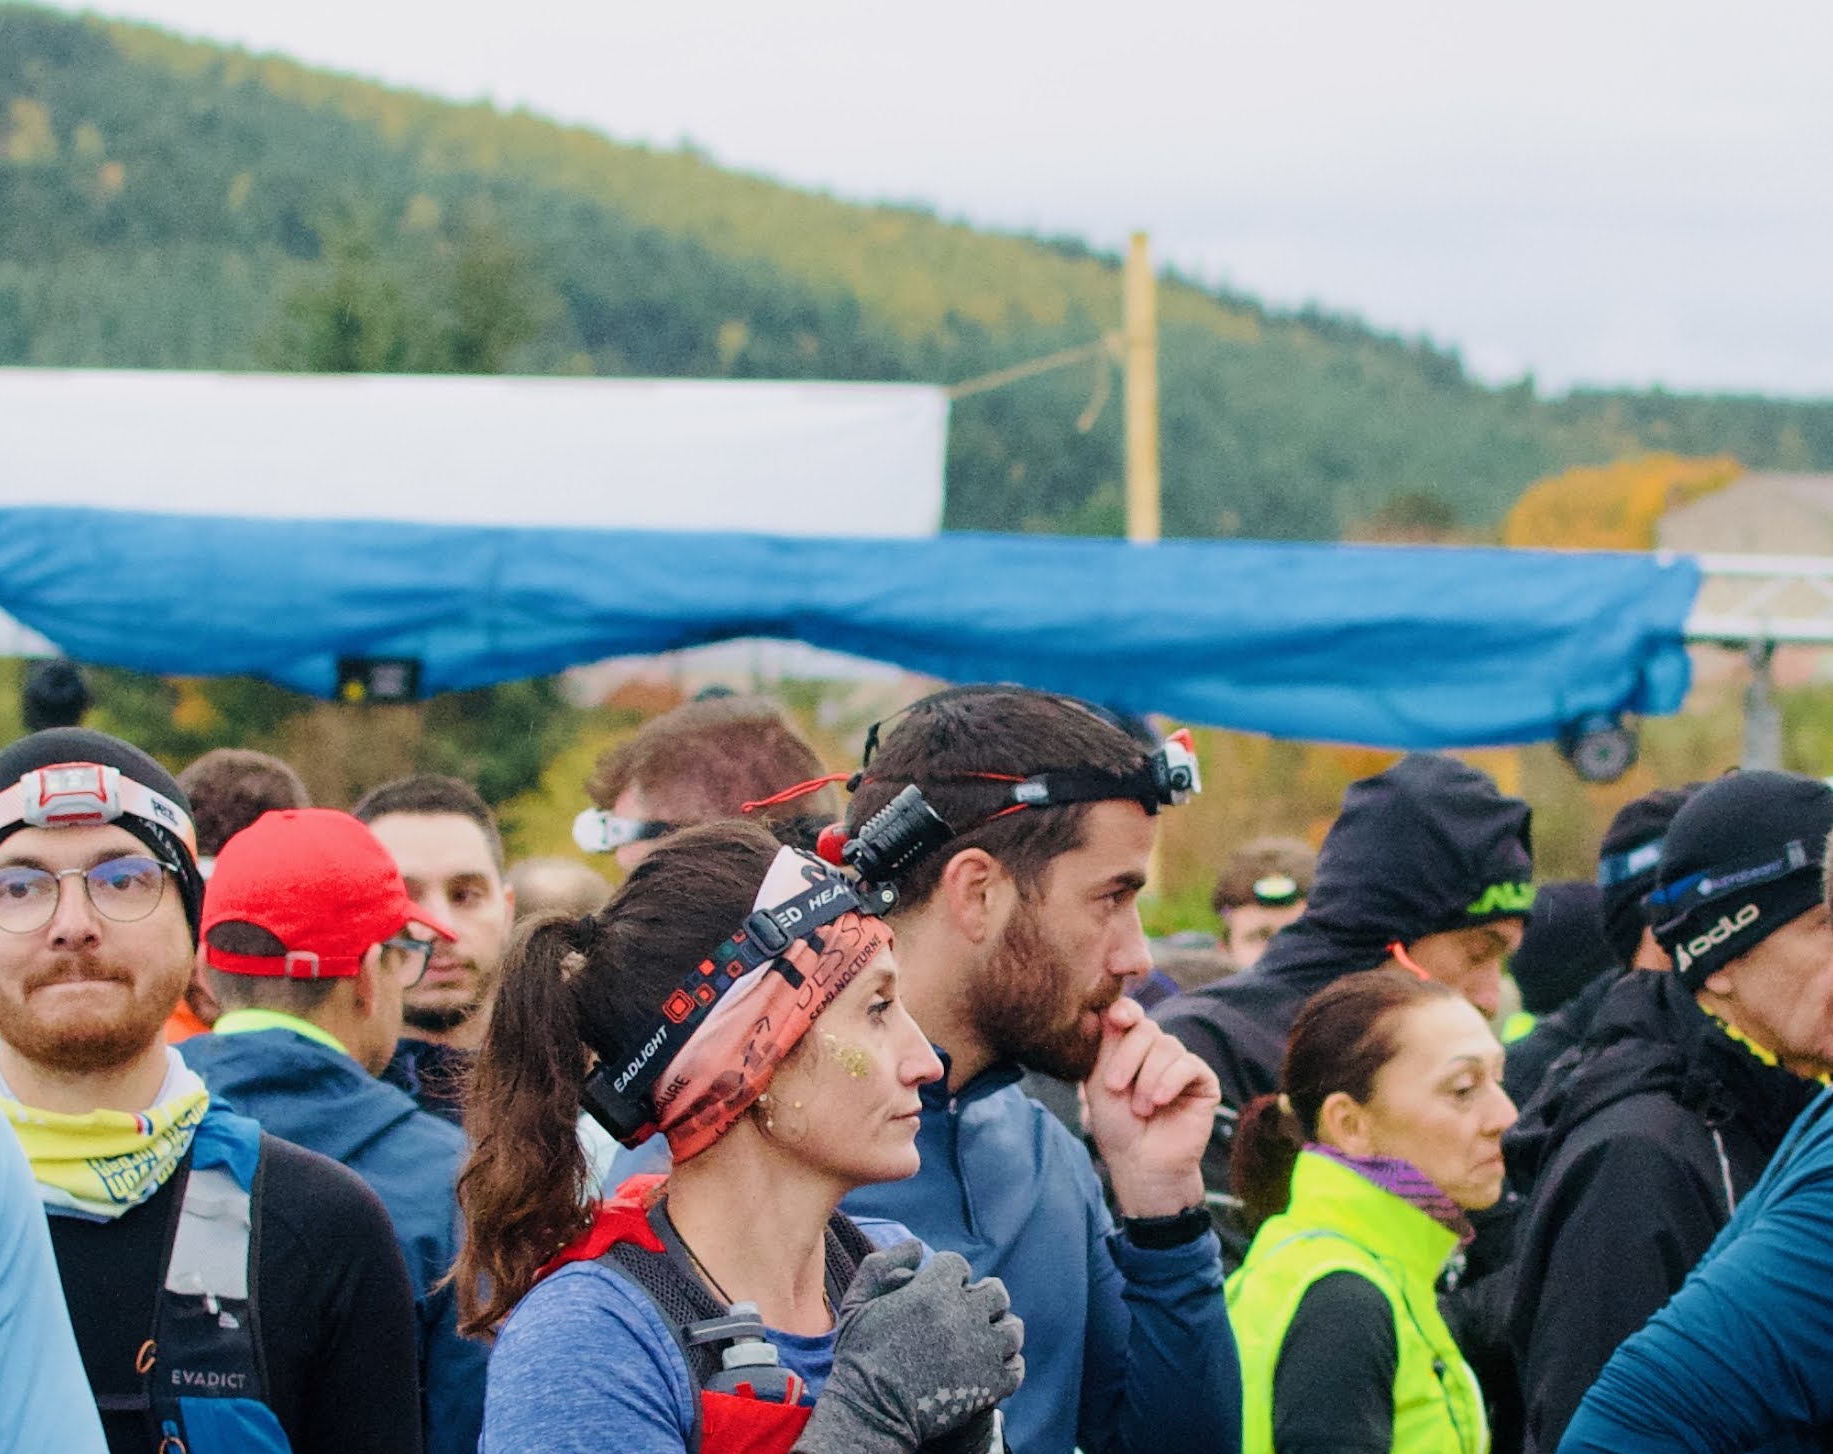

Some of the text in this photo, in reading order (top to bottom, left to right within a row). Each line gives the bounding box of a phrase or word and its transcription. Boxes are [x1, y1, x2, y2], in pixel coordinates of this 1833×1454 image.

[776, 905, 803, 929] ED
[613, 1025, 668, 1093] EADLIGHT
[171, 1369, 247, 1390] EVADICT
